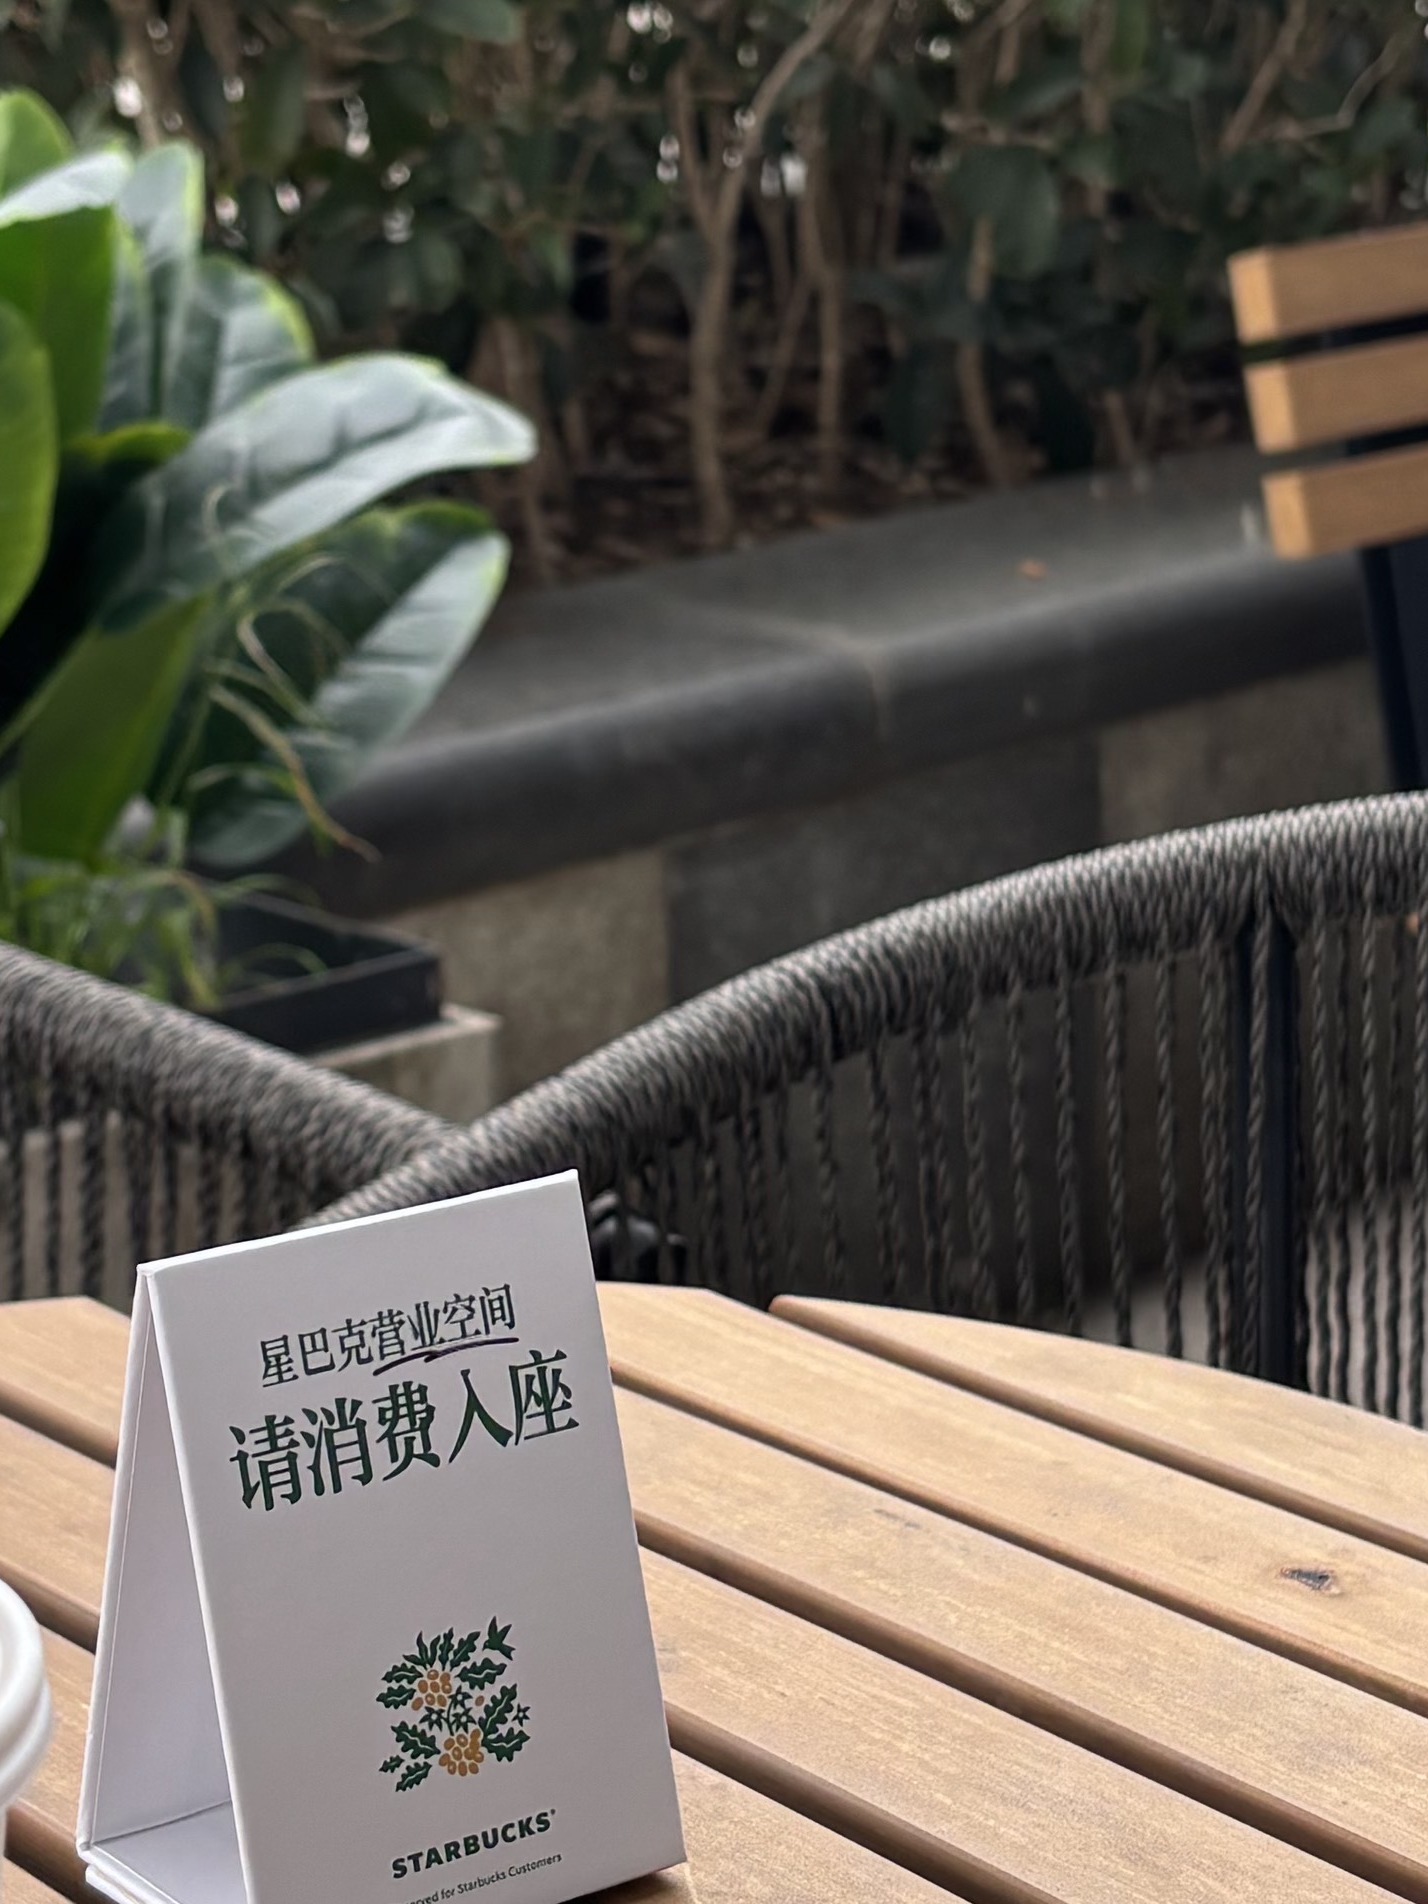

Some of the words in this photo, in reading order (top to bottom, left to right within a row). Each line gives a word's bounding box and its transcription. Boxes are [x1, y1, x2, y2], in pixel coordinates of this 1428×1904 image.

[260, 1283, 517, 1388] 星巴克营业空间
[228, 1349, 580, 1512] 请消费入座
[391, 1809, 556, 1880] STARBUCKS
[440, 1887, 456, 1901] for
[457, 1870, 507, 1895] Starbucks
[508, 1853, 563, 1878] Customers
